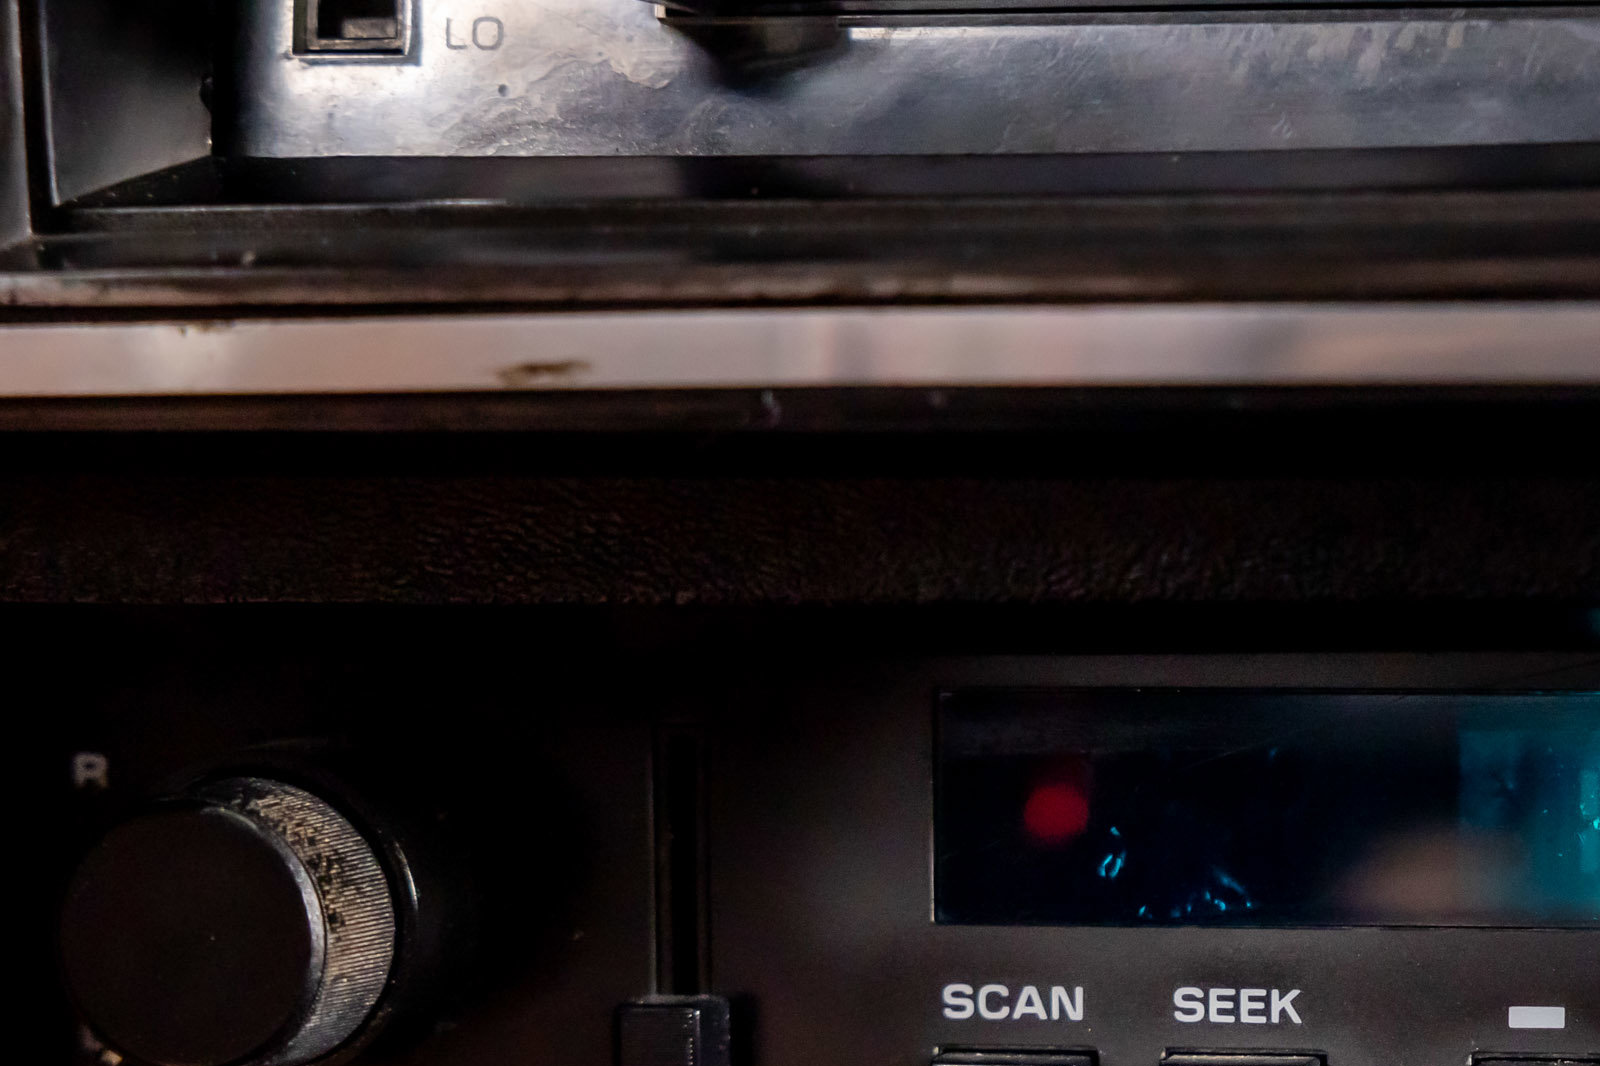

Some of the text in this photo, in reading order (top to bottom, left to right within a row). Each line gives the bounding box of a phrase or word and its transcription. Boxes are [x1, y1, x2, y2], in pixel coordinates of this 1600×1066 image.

[445, 16, 504, 50] LO
[73, 752, 109, 788] R
[942, 983, 1084, 1022] SCAN
[1173, 986, 1302, 1024] SEEK
